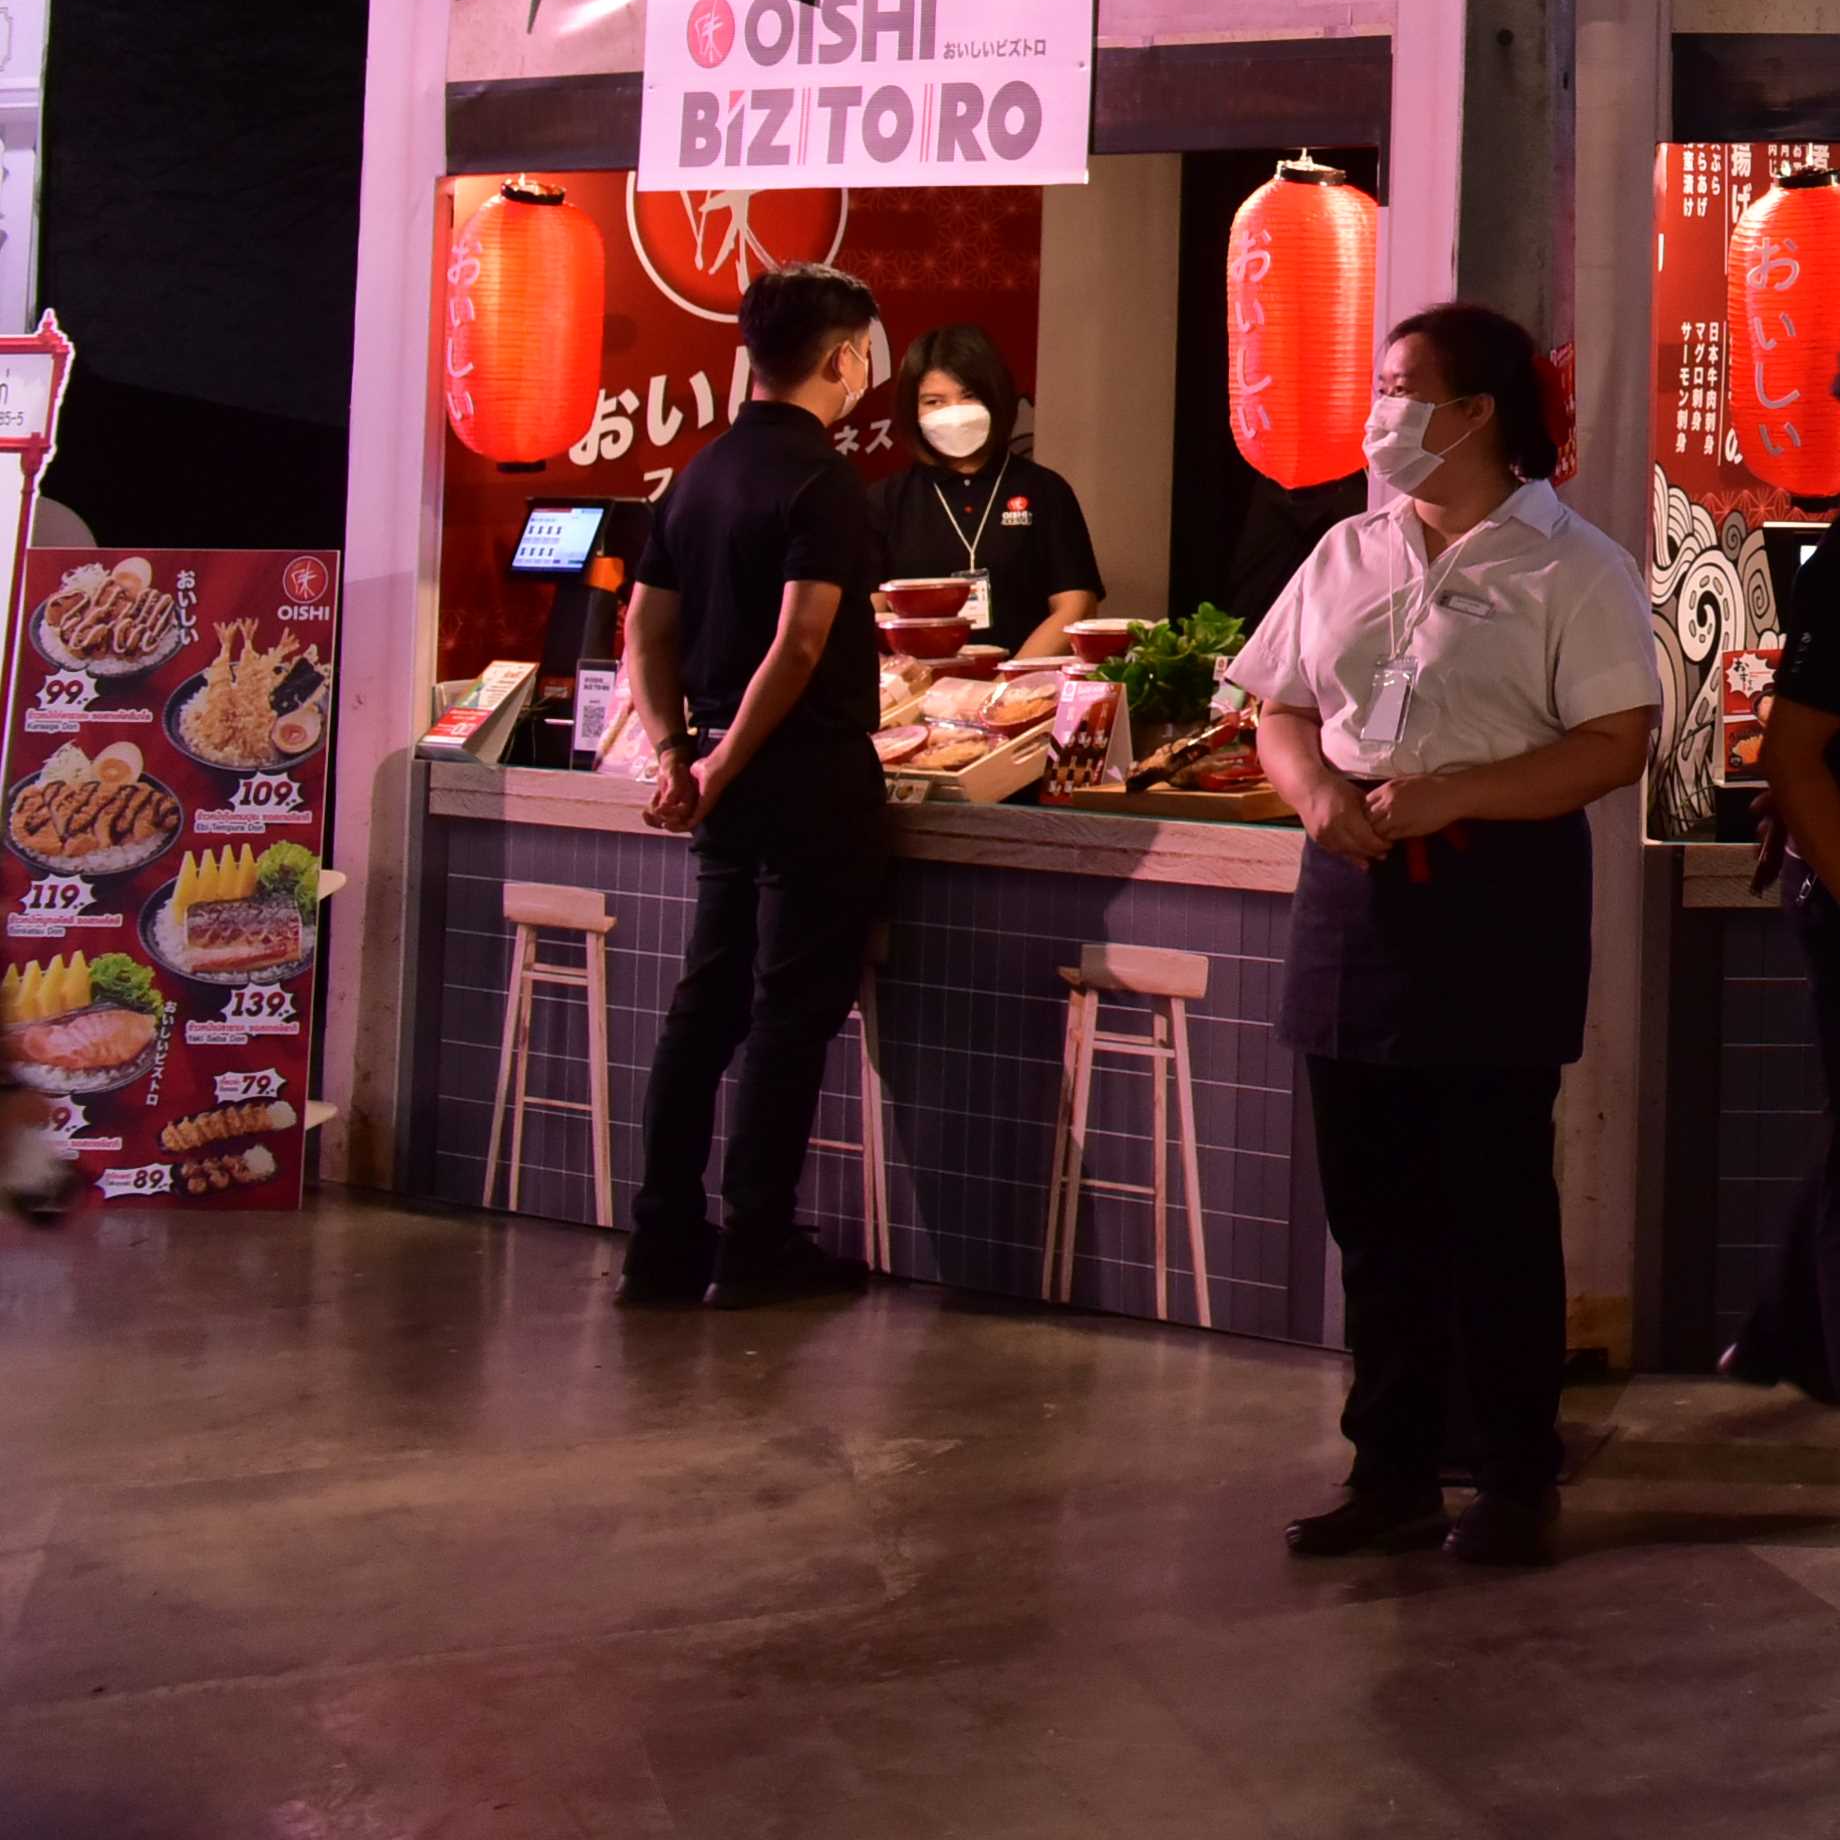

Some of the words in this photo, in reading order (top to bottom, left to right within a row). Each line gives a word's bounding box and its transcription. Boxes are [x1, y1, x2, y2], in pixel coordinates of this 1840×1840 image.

[1696, 143, 1708, 217] らあげ
[1710, 143, 1721, 196] ぷら
[1231, 229, 1273, 441] おいしい
[1745, 236, 1801, 457] おいしい
[176, 570, 199, 646] おいしい
[277, 606, 330, 621] OISHI
